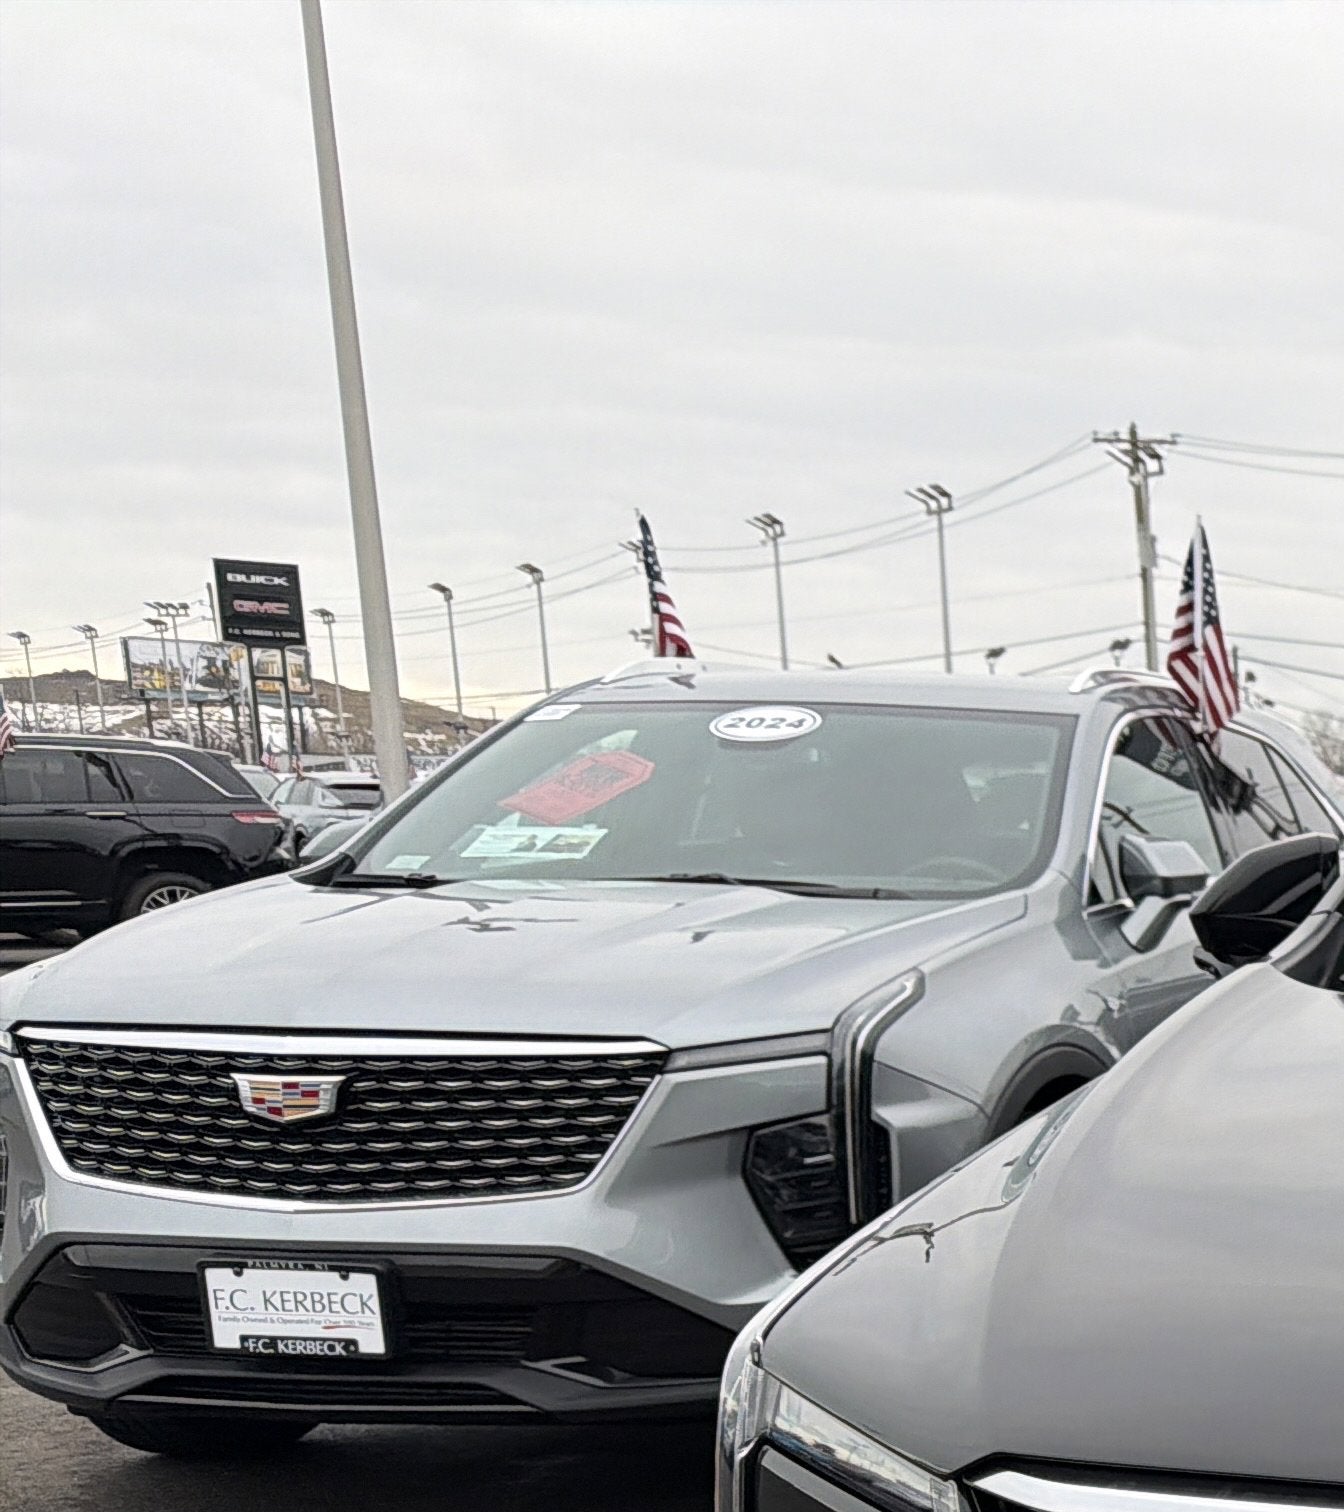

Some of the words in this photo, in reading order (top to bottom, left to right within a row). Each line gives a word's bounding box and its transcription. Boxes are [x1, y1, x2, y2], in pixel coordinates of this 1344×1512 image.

[724, 717, 806, 729] 2024
[212, 1288, 256, 1312] F.C.
[262, 1289, 376, 1316] KERBECK
[248, 1338, 275, 1354] F.C.
[277, 1339, 348, 1356] KERBECK
